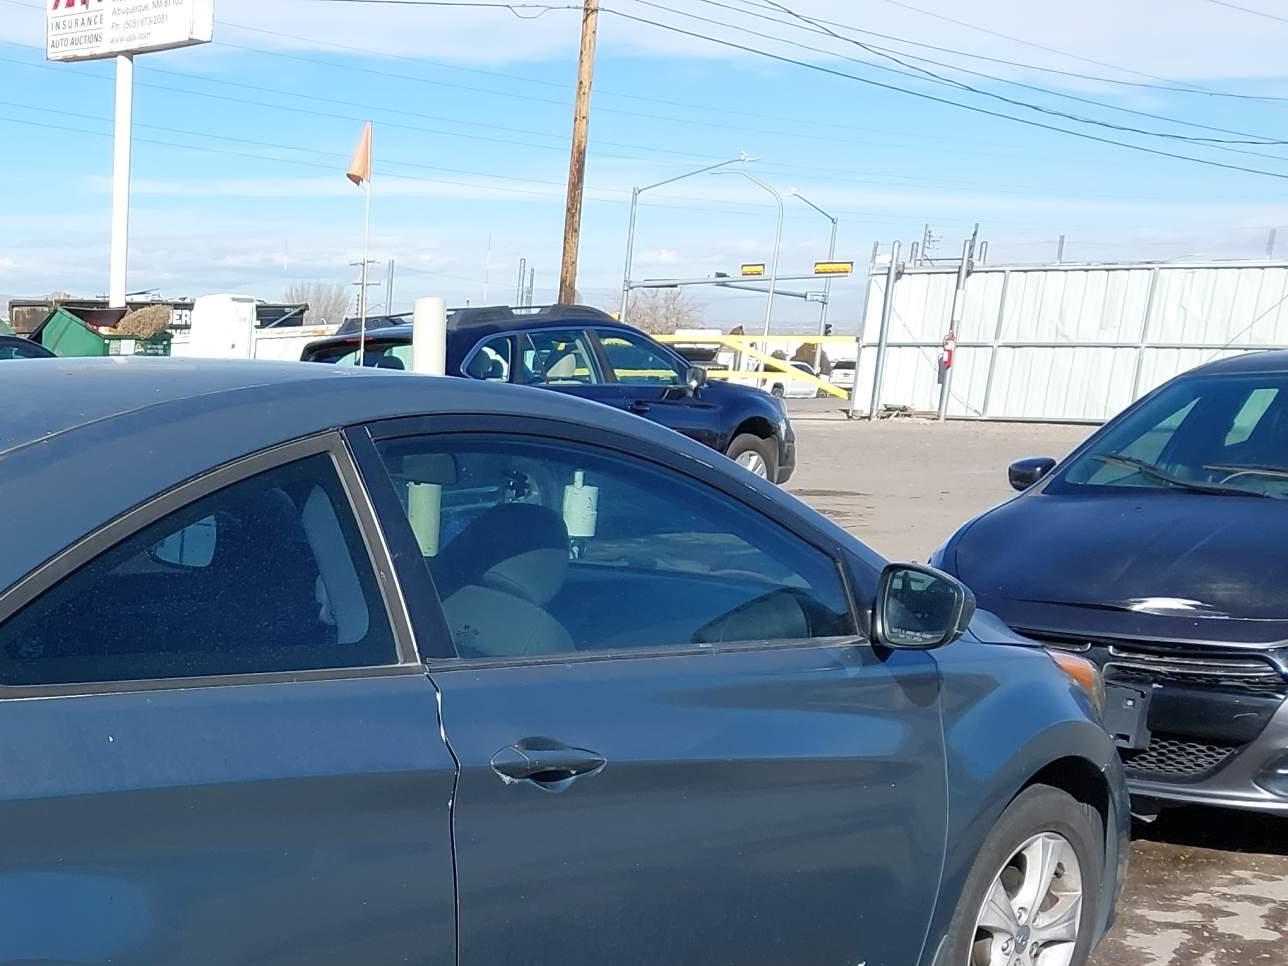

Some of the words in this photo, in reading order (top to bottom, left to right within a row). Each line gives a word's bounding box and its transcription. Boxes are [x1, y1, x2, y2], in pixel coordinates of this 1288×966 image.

[50, 13, 104, 32] INSURANCE
[50, 37, 69, 49] AUTO
[69, 31, 103, 46] AUCTIONS
